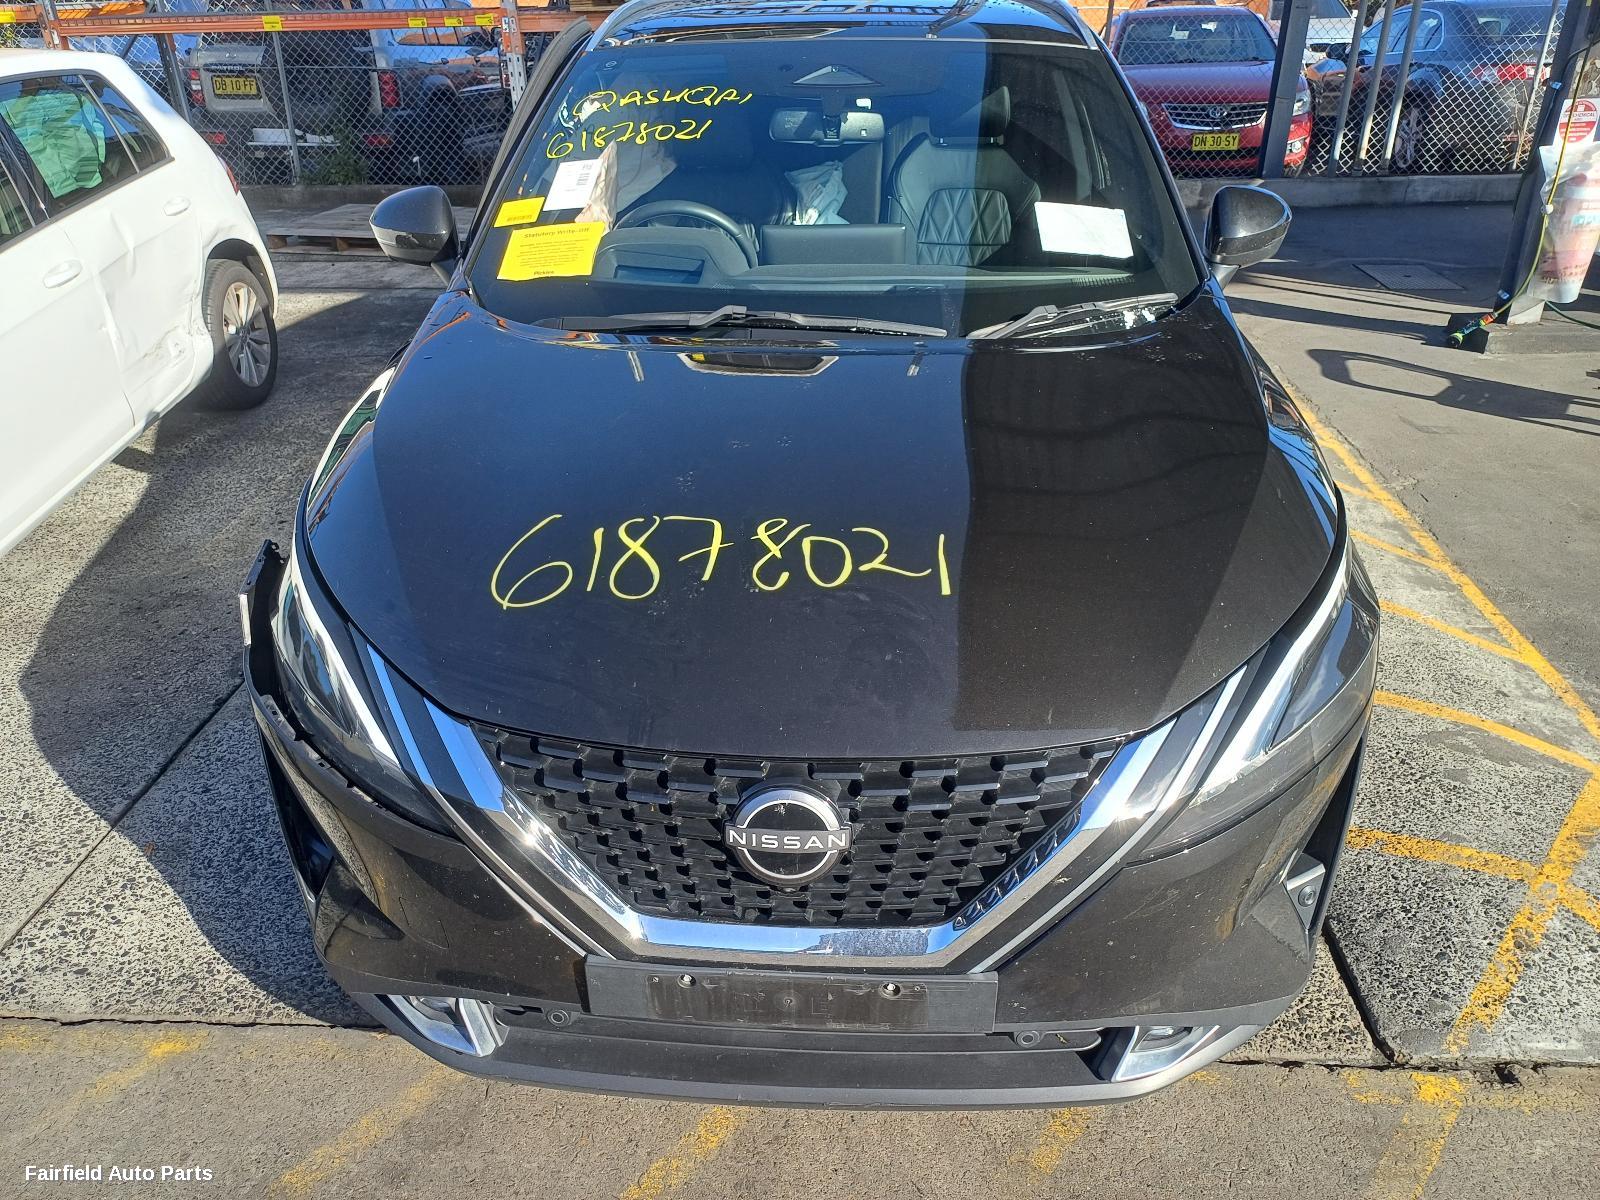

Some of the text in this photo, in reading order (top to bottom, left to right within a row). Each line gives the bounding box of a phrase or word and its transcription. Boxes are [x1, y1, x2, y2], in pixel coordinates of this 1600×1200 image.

[546, 119, 713, 159] 61878021
[490, 514, 951, 610] 61878021
[729, 829, 846, 850] NISSAN
